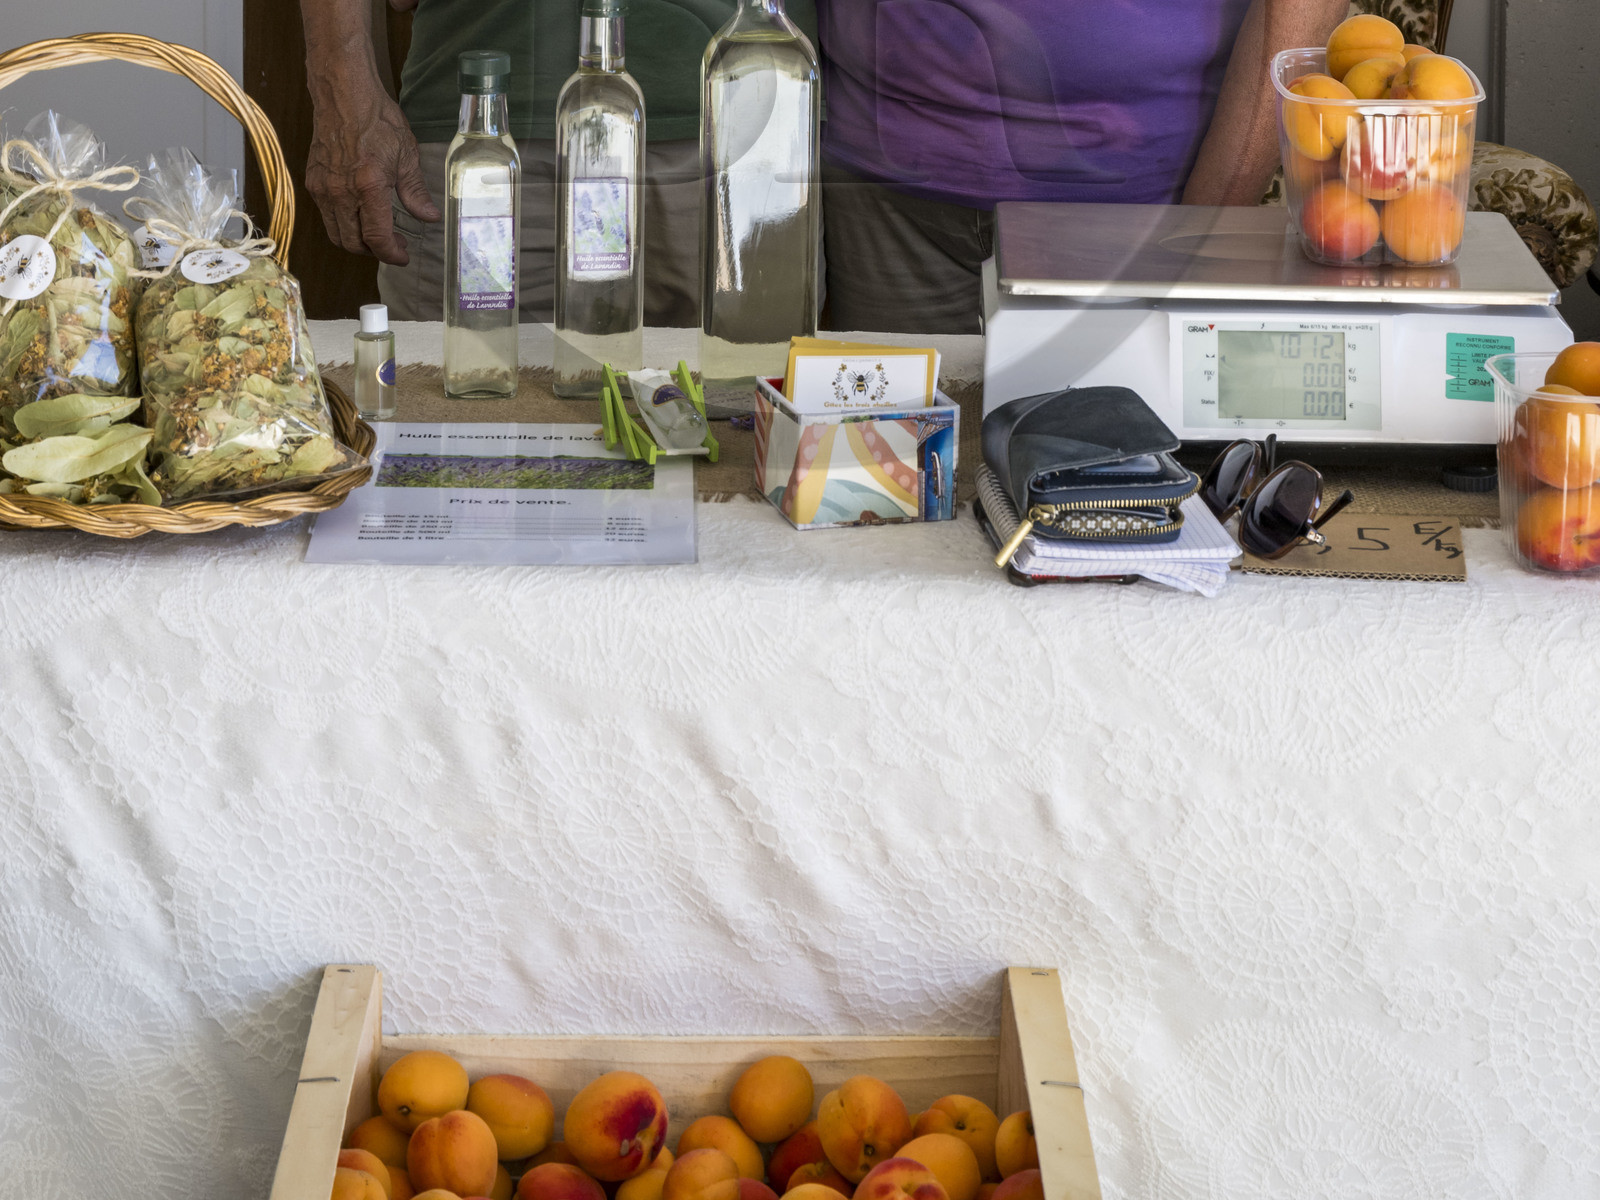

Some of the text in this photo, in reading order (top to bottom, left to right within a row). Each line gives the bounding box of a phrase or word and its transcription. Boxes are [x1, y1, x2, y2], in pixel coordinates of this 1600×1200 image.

[466, 301, 475, 309] de
[1347, 342, 1357, 351] kg
[1303, 362, 1342, 388] 0.00
[1348, 375, 1357, 383] kg
[1468, 378, 1491, 387] GRAM
[1303, 391, 1343, 416] 0.00
